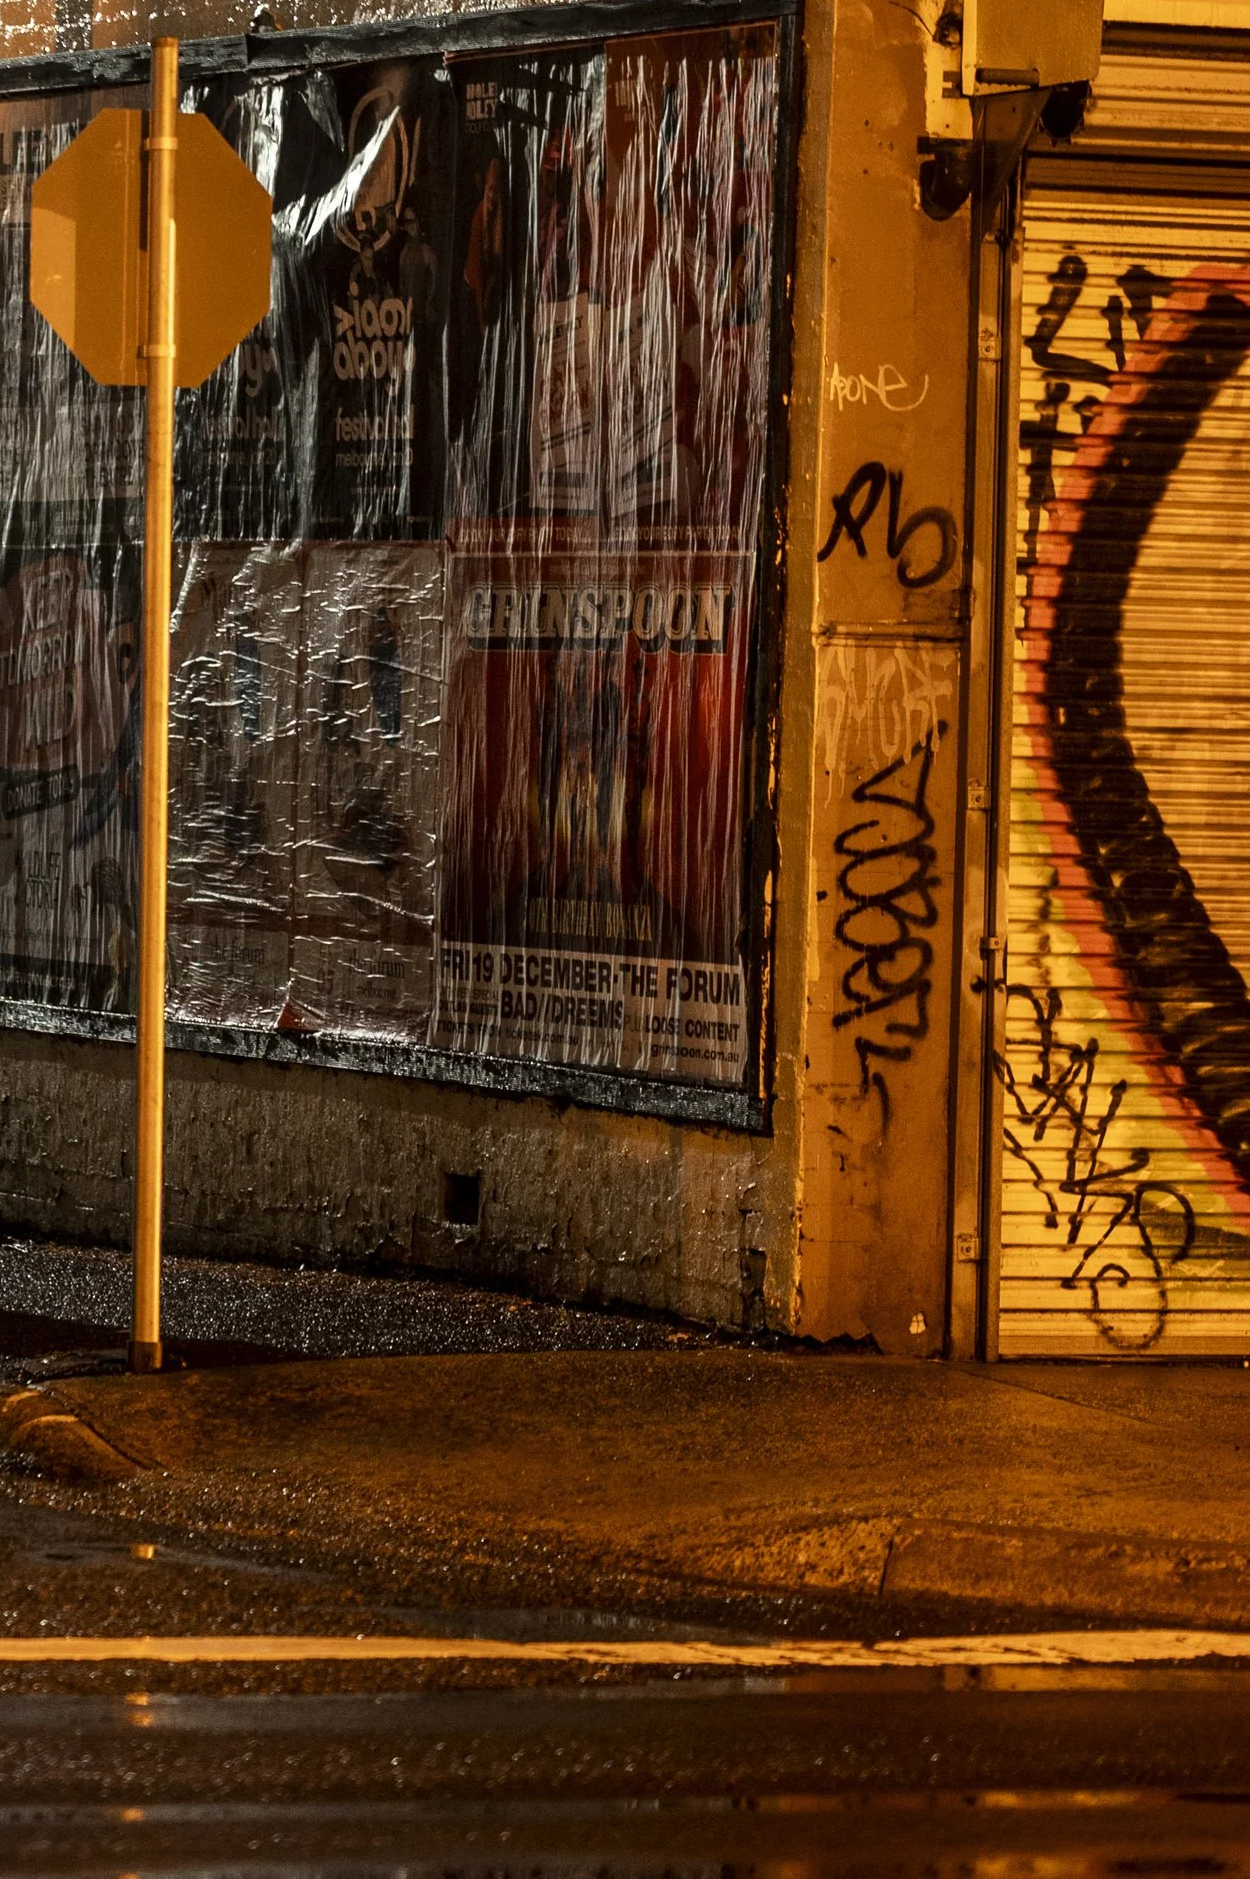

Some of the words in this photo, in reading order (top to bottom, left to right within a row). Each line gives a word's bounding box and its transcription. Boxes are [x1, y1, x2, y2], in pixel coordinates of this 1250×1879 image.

[464, 581, 733, 651] GRINSPOON
[440, 948, 470, 982] FRI
[473, 952, 494, 983] 19
[666, 967, 740, 1006] FORUM
[685, 1019, 740, 1042] CONTENT
